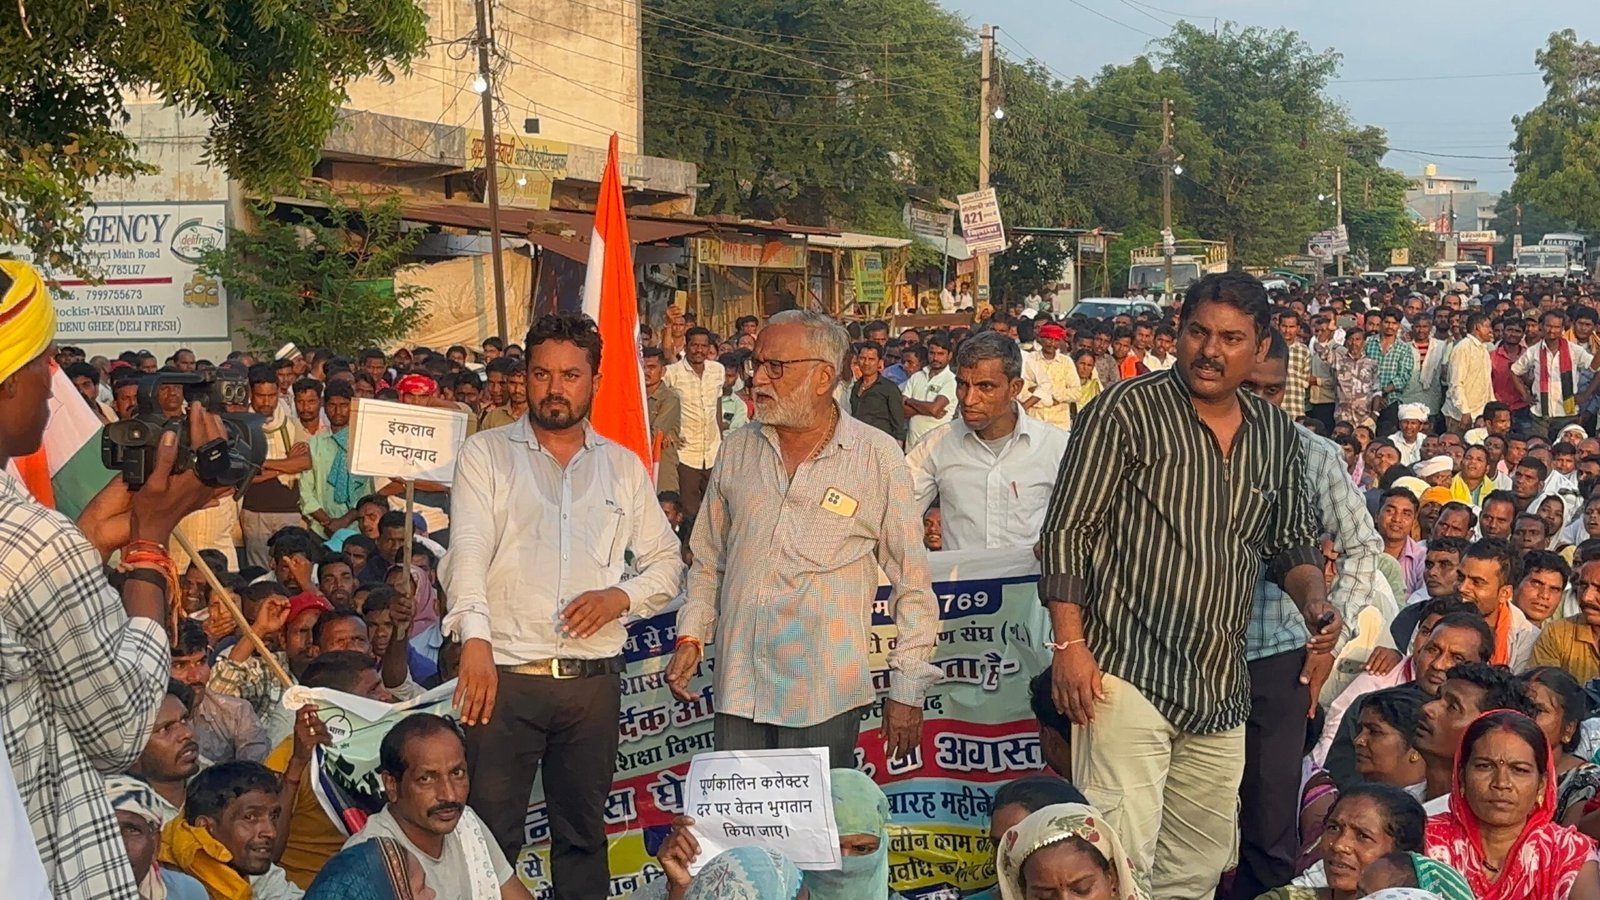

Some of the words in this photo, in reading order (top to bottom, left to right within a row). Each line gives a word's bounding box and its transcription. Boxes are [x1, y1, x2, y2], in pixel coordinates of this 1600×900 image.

[963, 211, 983, 225] 421
[82, 214, 171, 244] GENCY
[113, 249, 136, 260] Main
[138, 248, 160, 259] Road
[86, 290, 143, 301] 7999755673
[54, 306, 135, 317] tockist-VISAKHA
[137, 305, 165, 315] DAIRY
[88, 321, 114, 331] GHEE
[642, 626, 663, 649] से
[940, 592, 989, 614] 769
[960, 620, 994, 643] संघ
[665, 731, 715, 758] विभा
[939, 737, 1044, 768] अगस्त
[760, 771, 809, 789] कलेक्टर
[697, 803, 711, 817] दर
[714, 802, 731, 816] पर
[734, 798, 763, 815] वेतन
[768, 800, 812, 818] भुगतान
[723, 823, 756, 838] किया
[757, 825, 790, 840] जाए।
